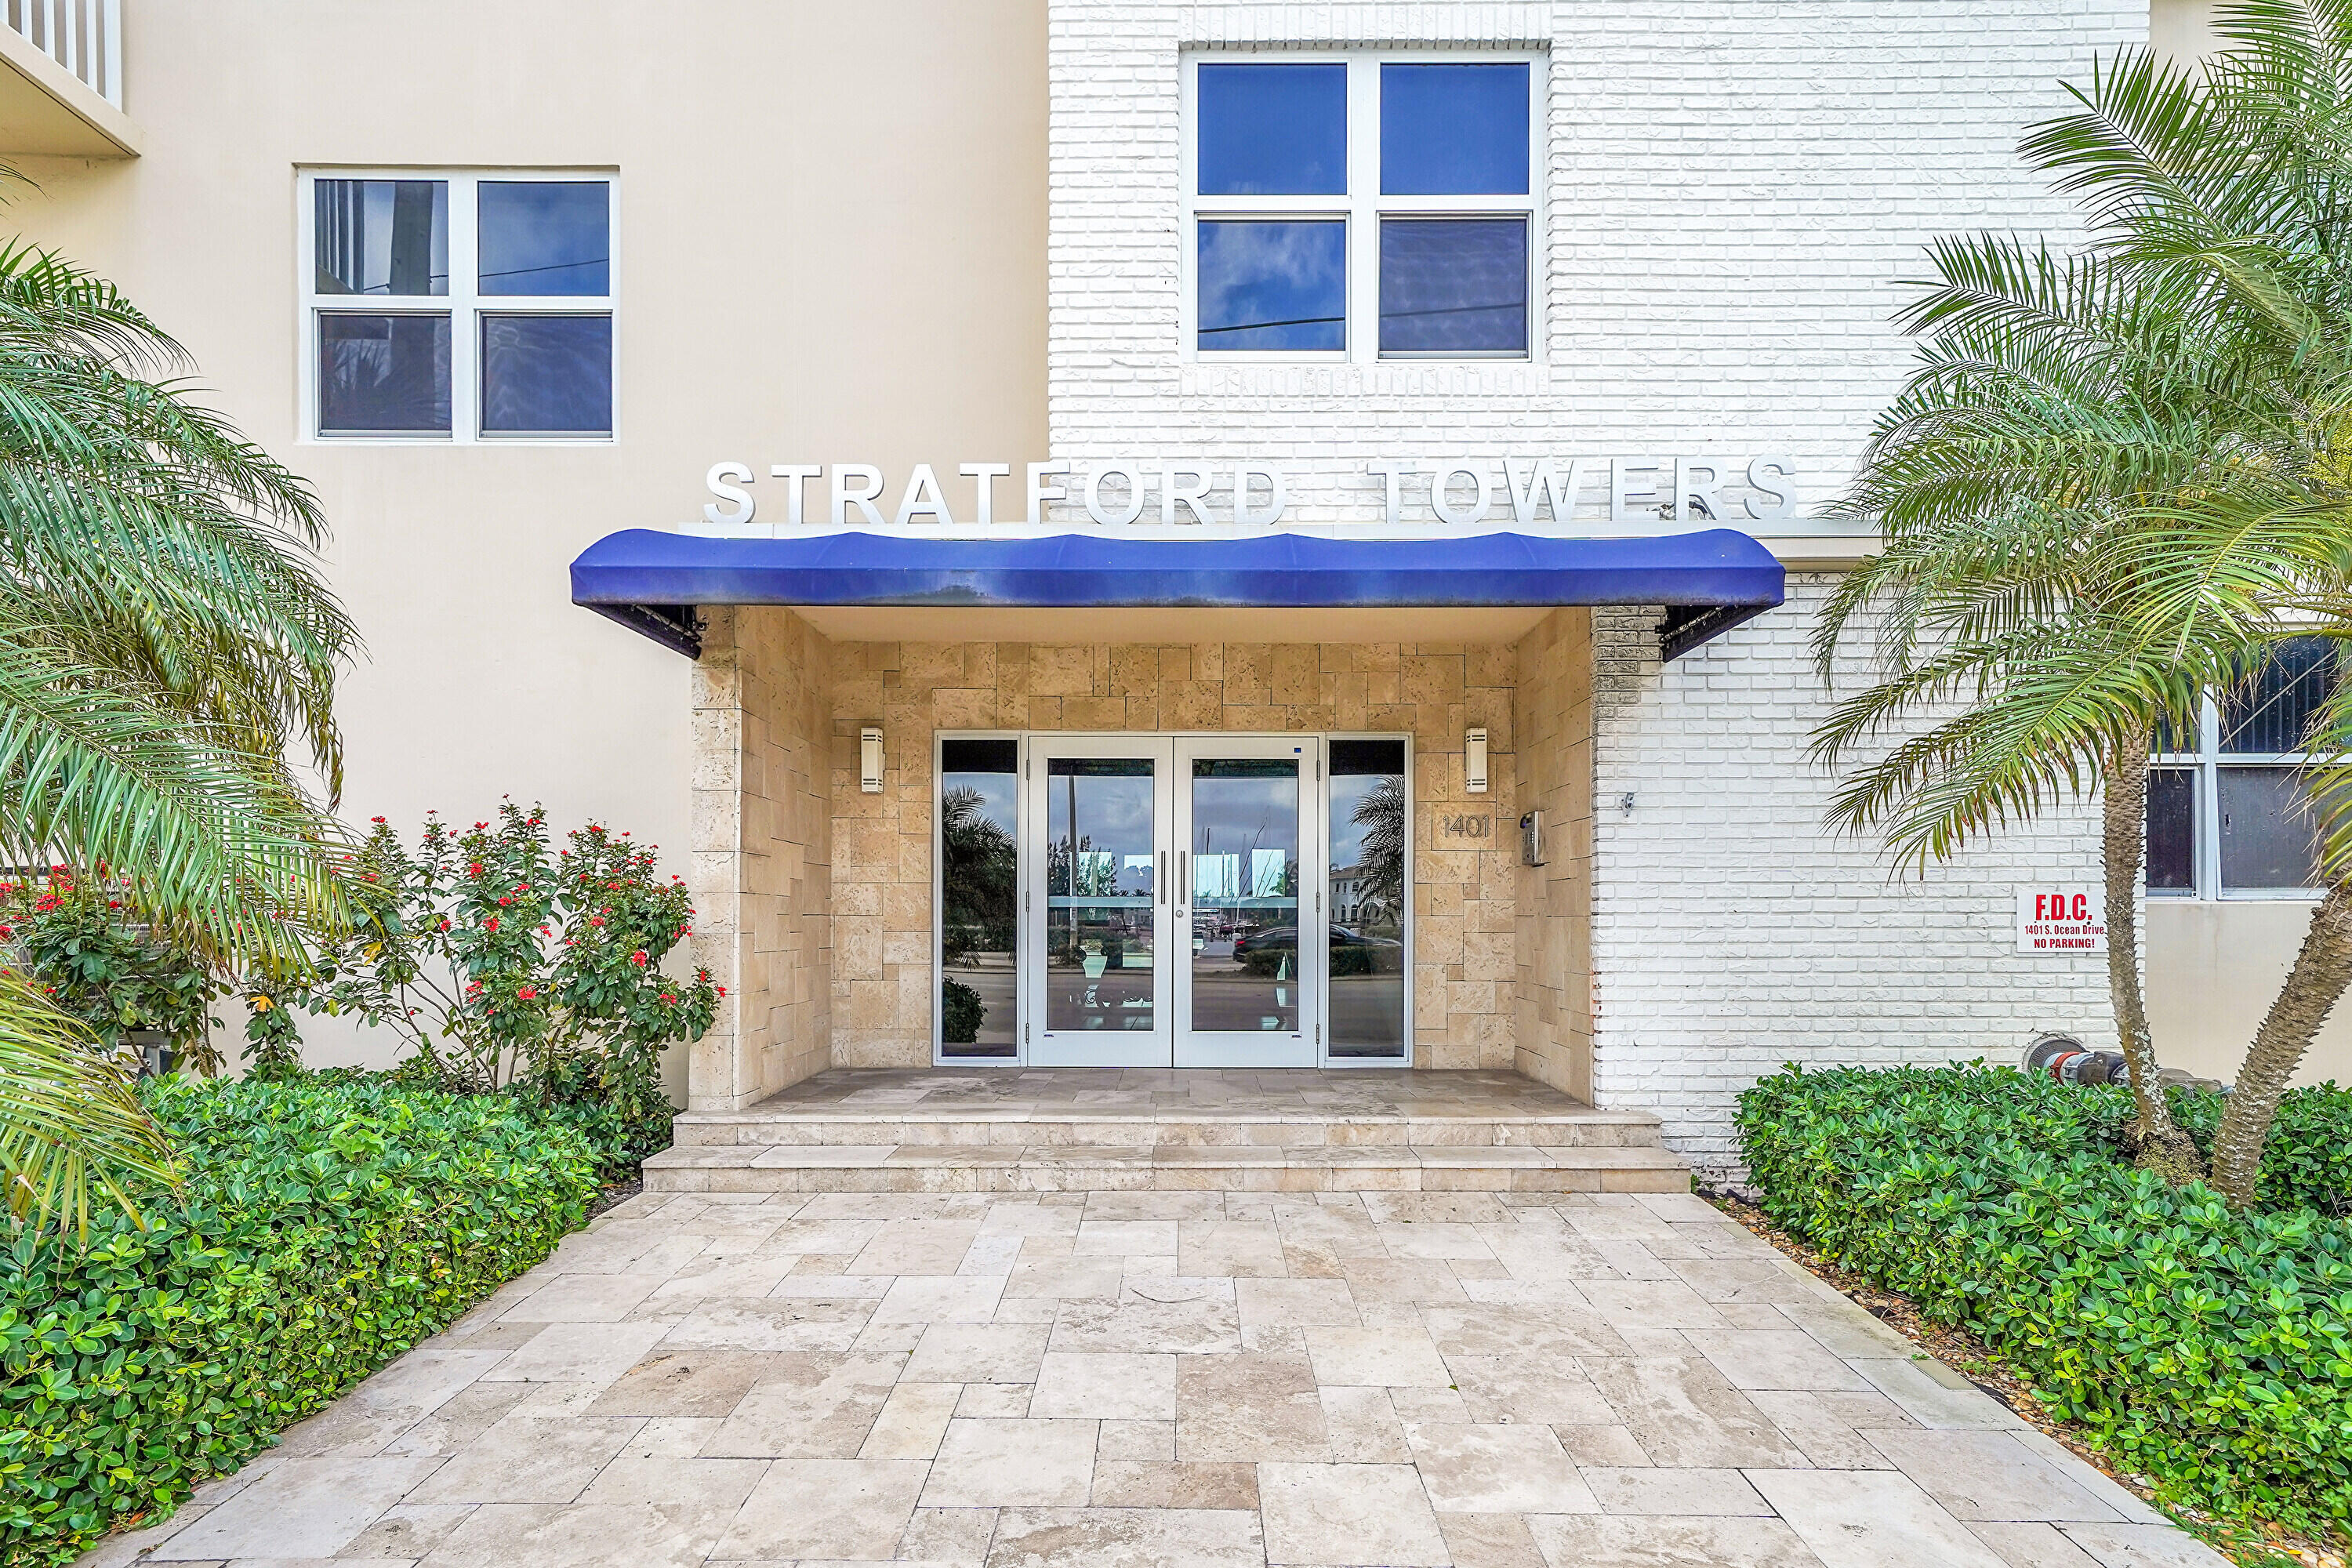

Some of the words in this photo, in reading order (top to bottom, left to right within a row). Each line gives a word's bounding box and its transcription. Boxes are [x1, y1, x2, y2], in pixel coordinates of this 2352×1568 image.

[703, 461, 1287, 525] STRATFORD
[1367, 453, 1796, 524] TOWERS
[1443, 815, 1490, 837] 1401
[2035, 894, 2092, 920] F.D.C.
[2025, 925, 2043, 935] 1401
[2045, 925, 2053, 935] S.
[2054, 925, 2080, 935] Ocean
[2034, 938, 2046, 948] NO
[2049, 938, 2095, 948] PARKING!
